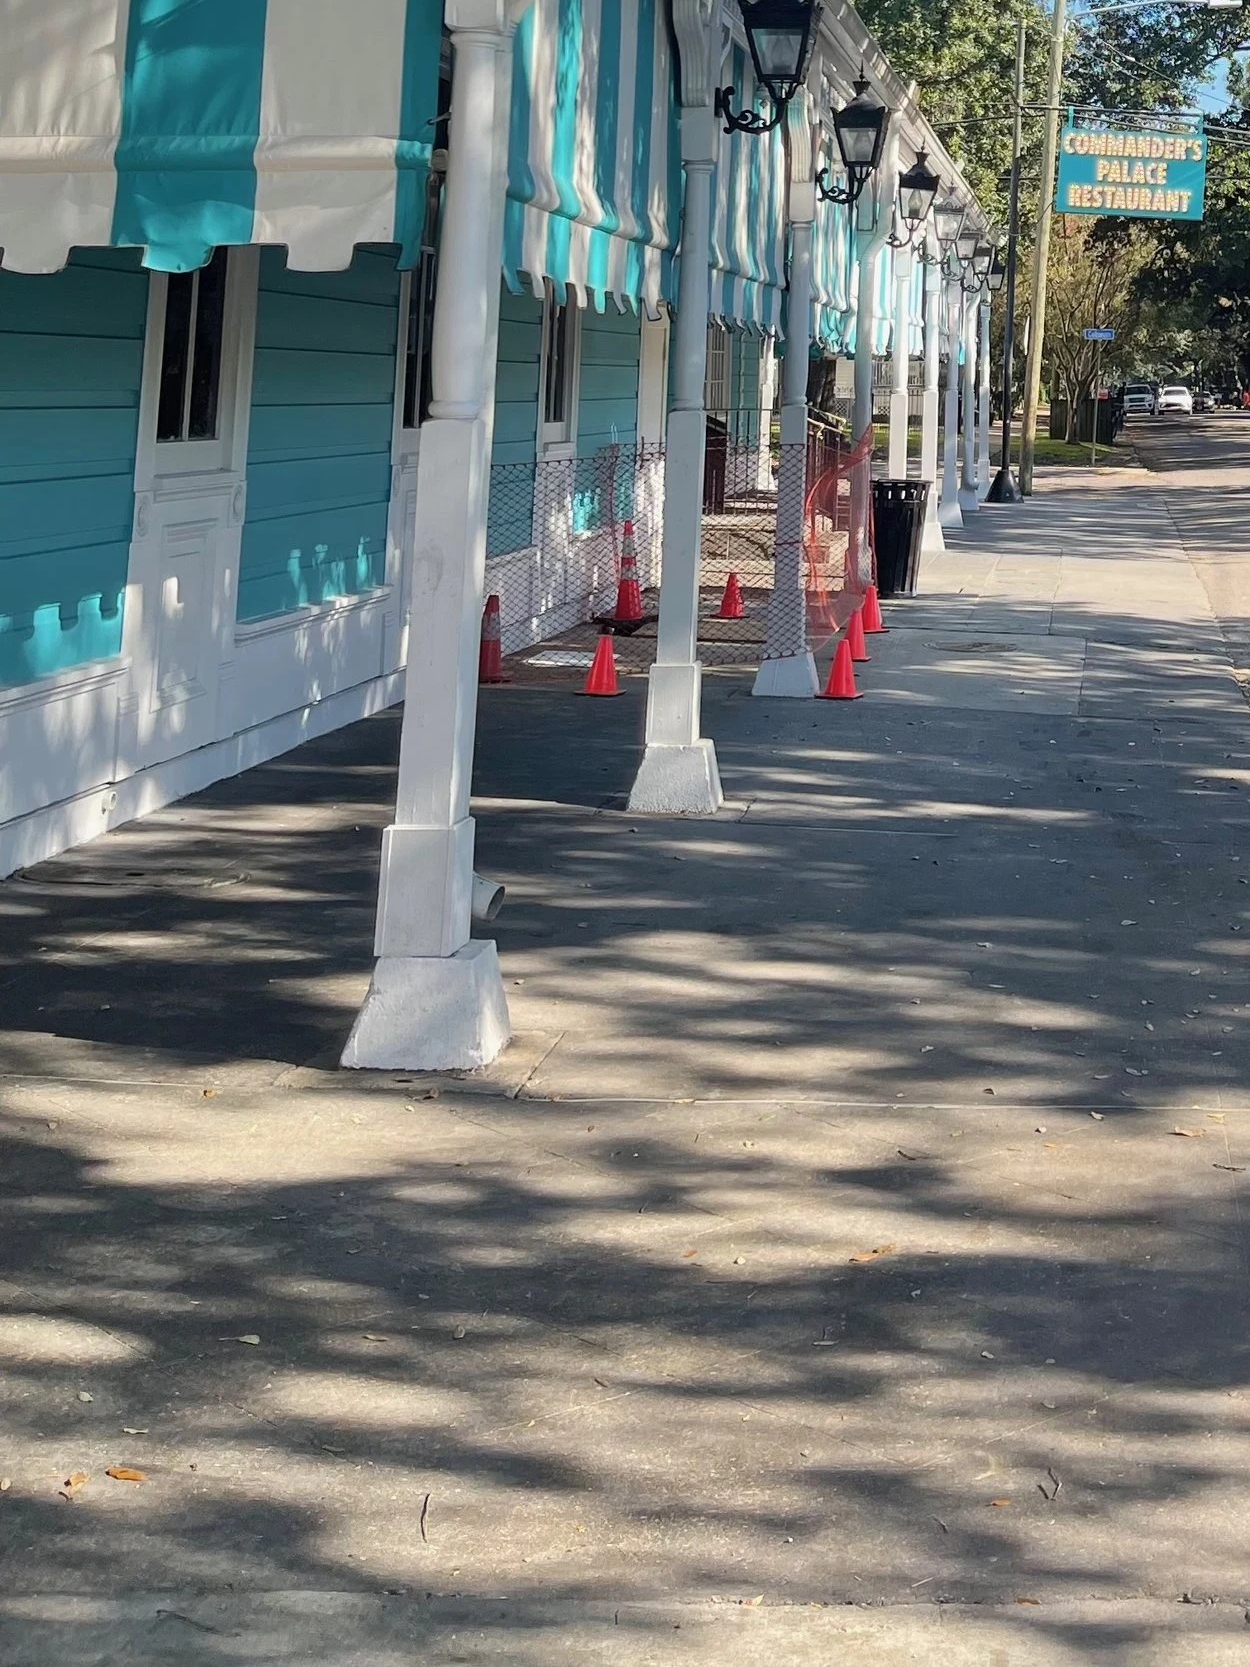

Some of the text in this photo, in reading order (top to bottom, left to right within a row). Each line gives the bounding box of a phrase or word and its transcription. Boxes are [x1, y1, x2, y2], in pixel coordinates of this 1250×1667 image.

[1064, 133, 1203, 161] COMMANDER'S
[1097, 160, 1168, 185] PALACE
[1067, 184, 1192, 212] RESTAURANT
